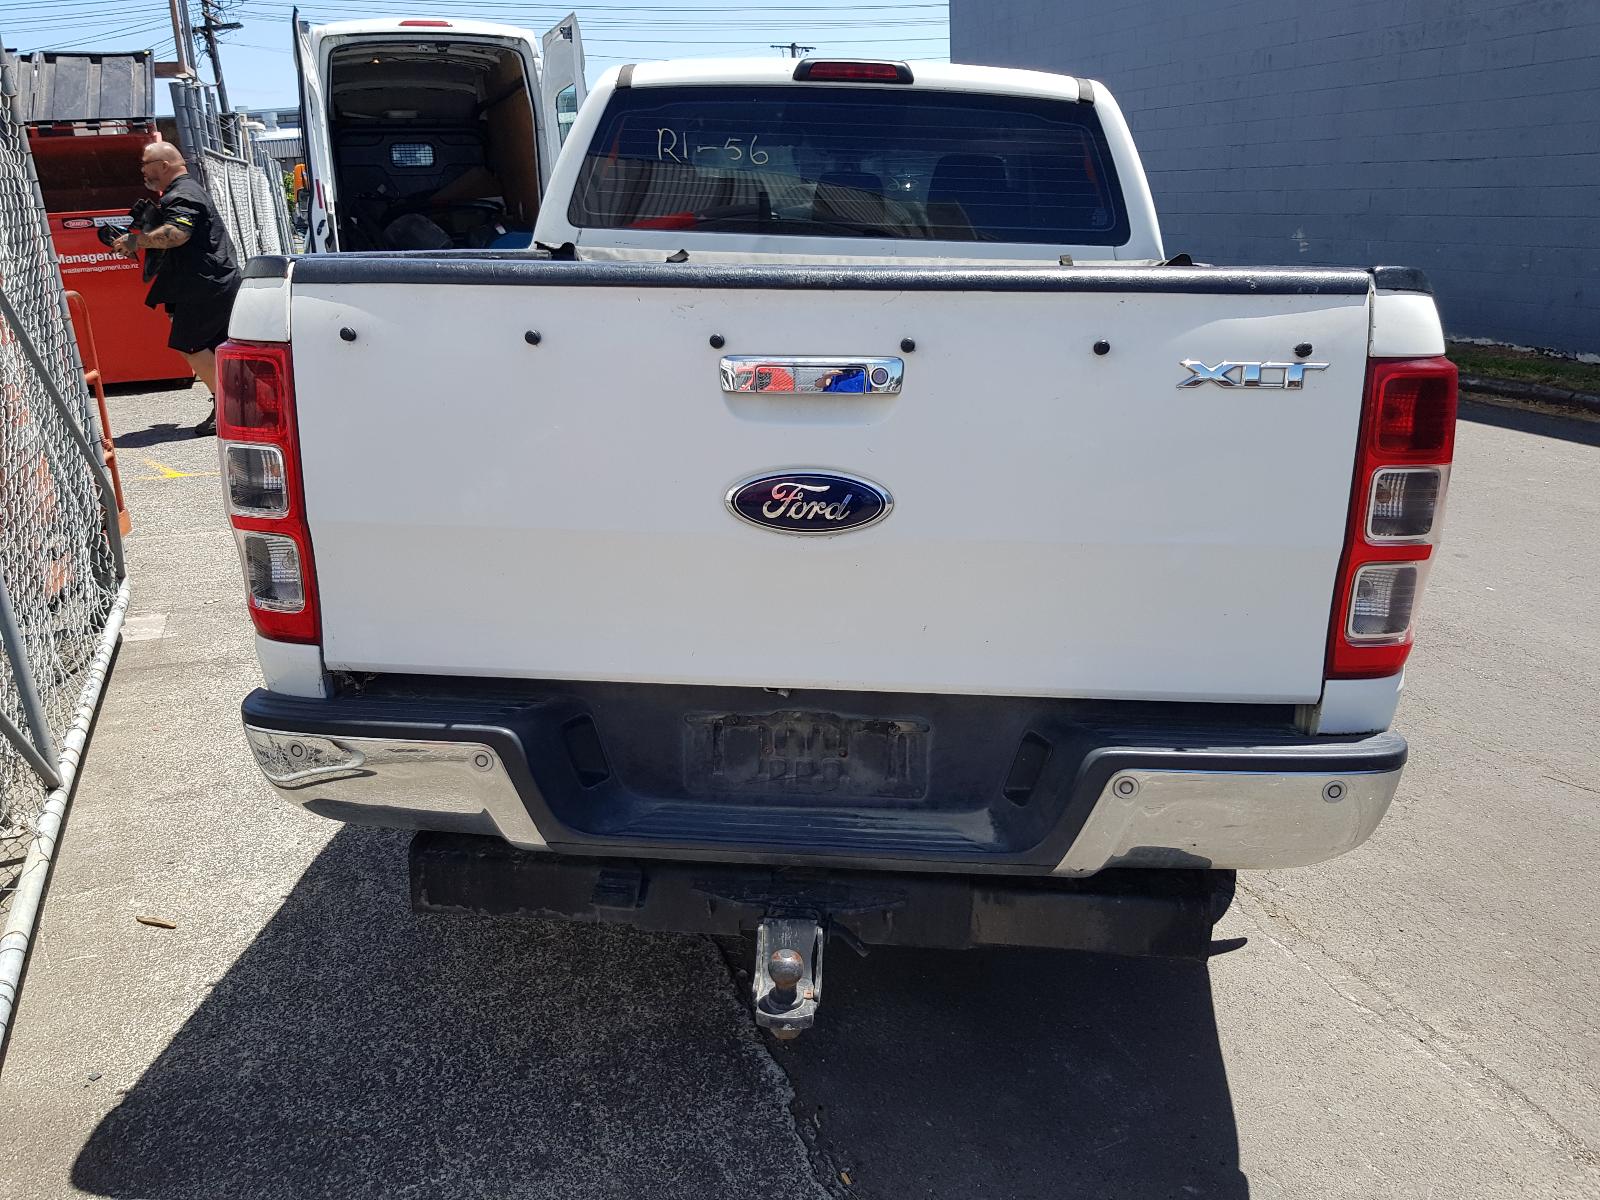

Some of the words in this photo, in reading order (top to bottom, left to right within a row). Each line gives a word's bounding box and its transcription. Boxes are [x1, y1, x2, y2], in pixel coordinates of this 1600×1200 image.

[57, 252, 127, 263] Manageme
[62, 263, 139, 274] wastemanagement.co.nz
[1176, 359, 1331, 390] XLT
[762, 482, 853, 521] Ford
